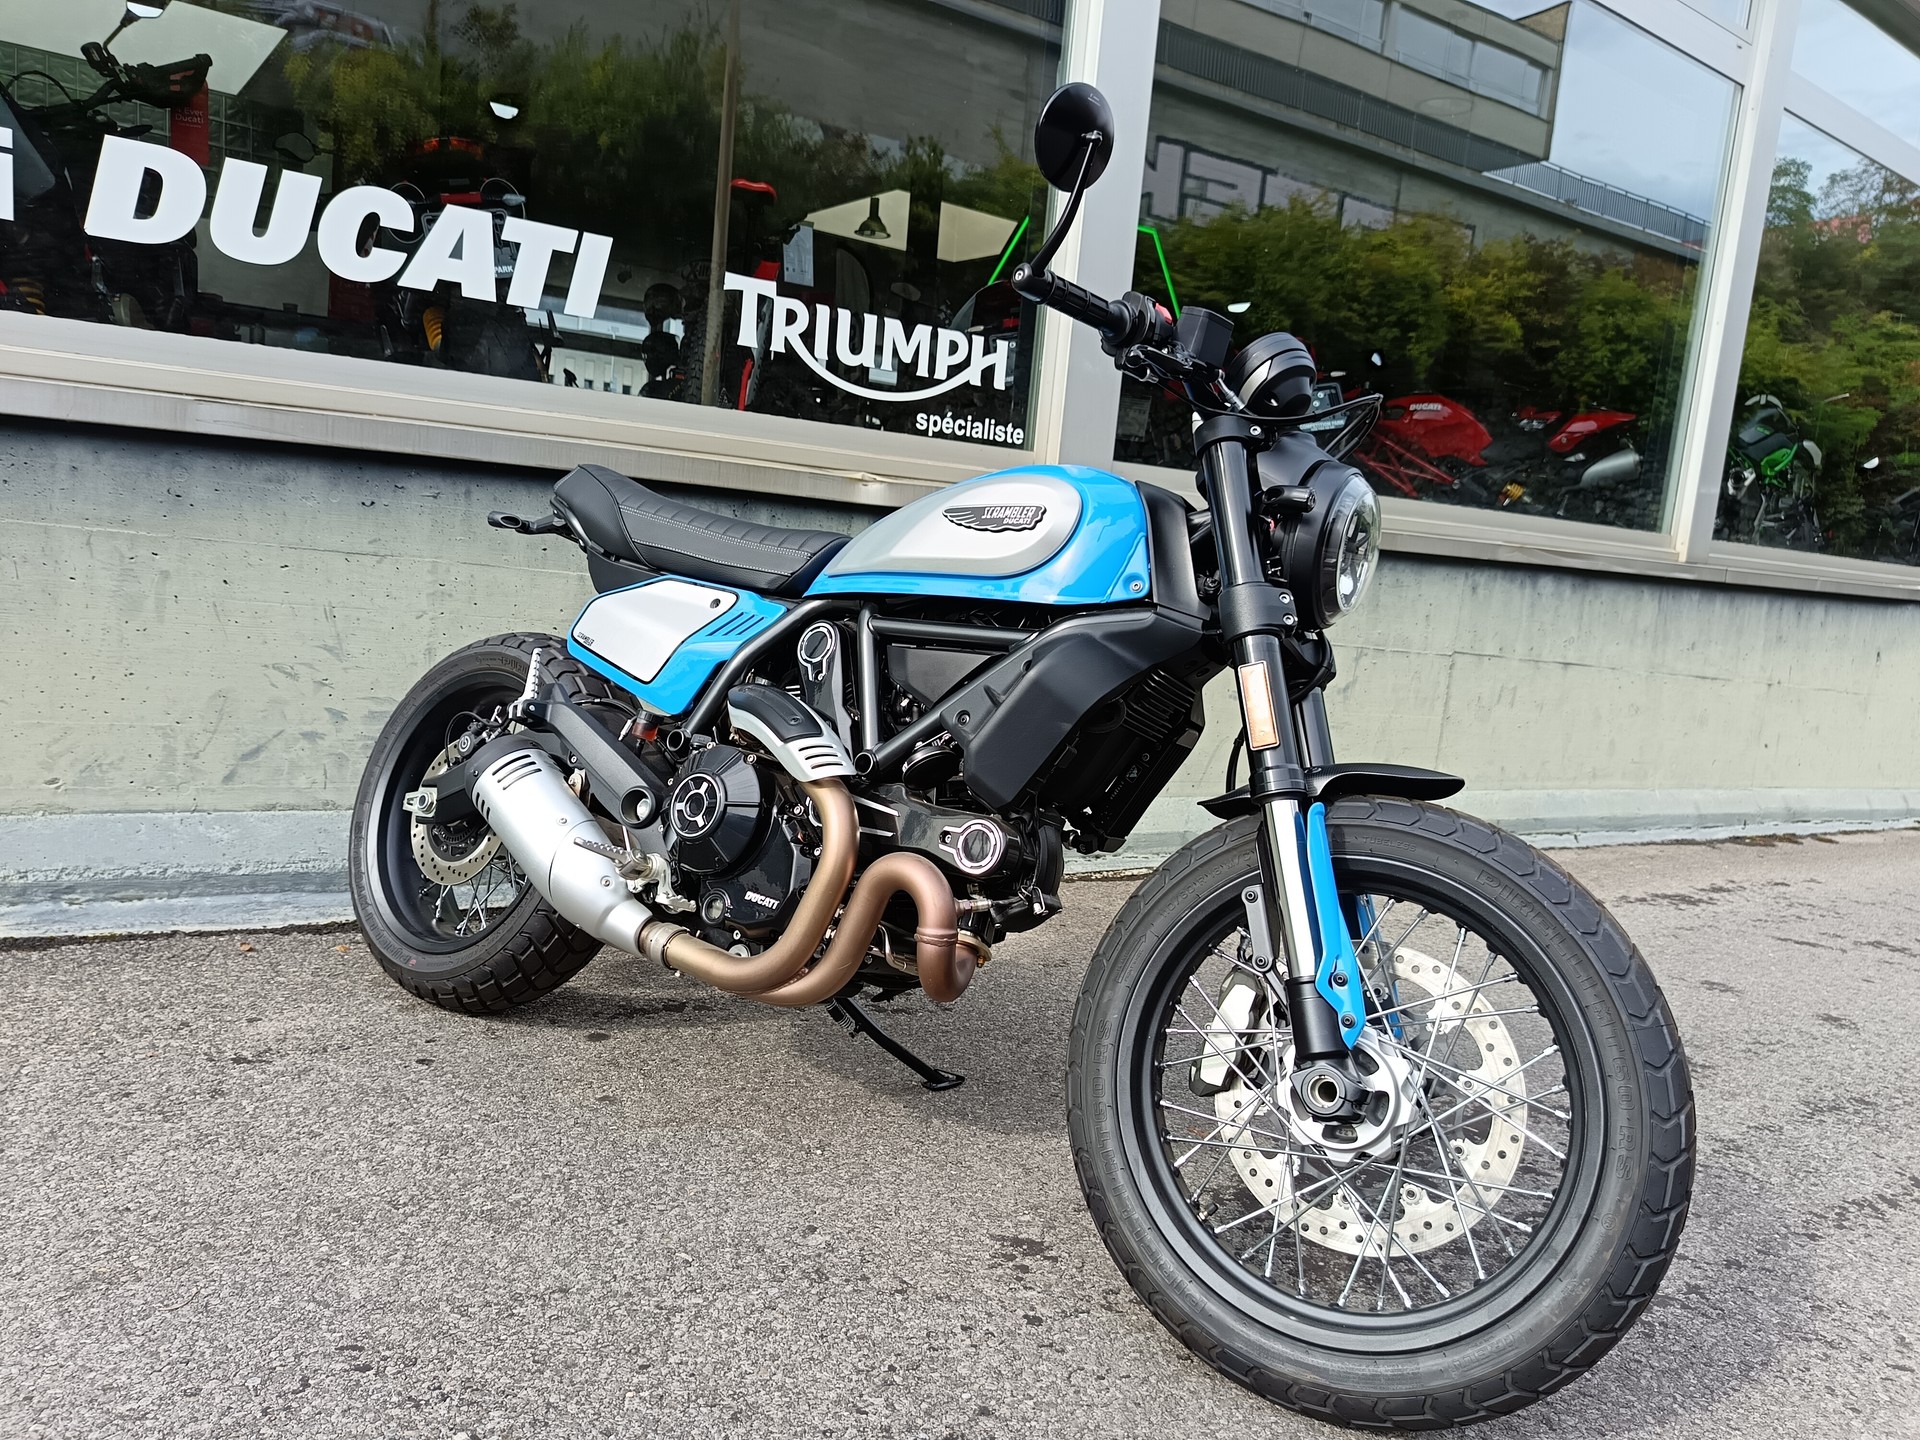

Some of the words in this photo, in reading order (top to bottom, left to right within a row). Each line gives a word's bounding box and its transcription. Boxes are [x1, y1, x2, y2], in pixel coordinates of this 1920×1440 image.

[175, 113, 204, 124] Ducati
[84, 134, 613, 319] DUCATI
[723, 271, 1009, 401] TRIUMPH
[1409, 402, 1442, 411] DUCATI
[915, 410, 1025, 445] spécialiste
[981, 506, 1036, 519] SCRAMBLER
[1362, 836, 1417, 852] TUBELESS
[744, 890, 780, 910] DUCATI
[1091, 1019, 1112, 1065] RS
[1475, 868, 1598, 994] PIRELLI
[1616, 1123, 1636, 1181] RS
[1111, 1182, 1208, 1315] PIRELLI
